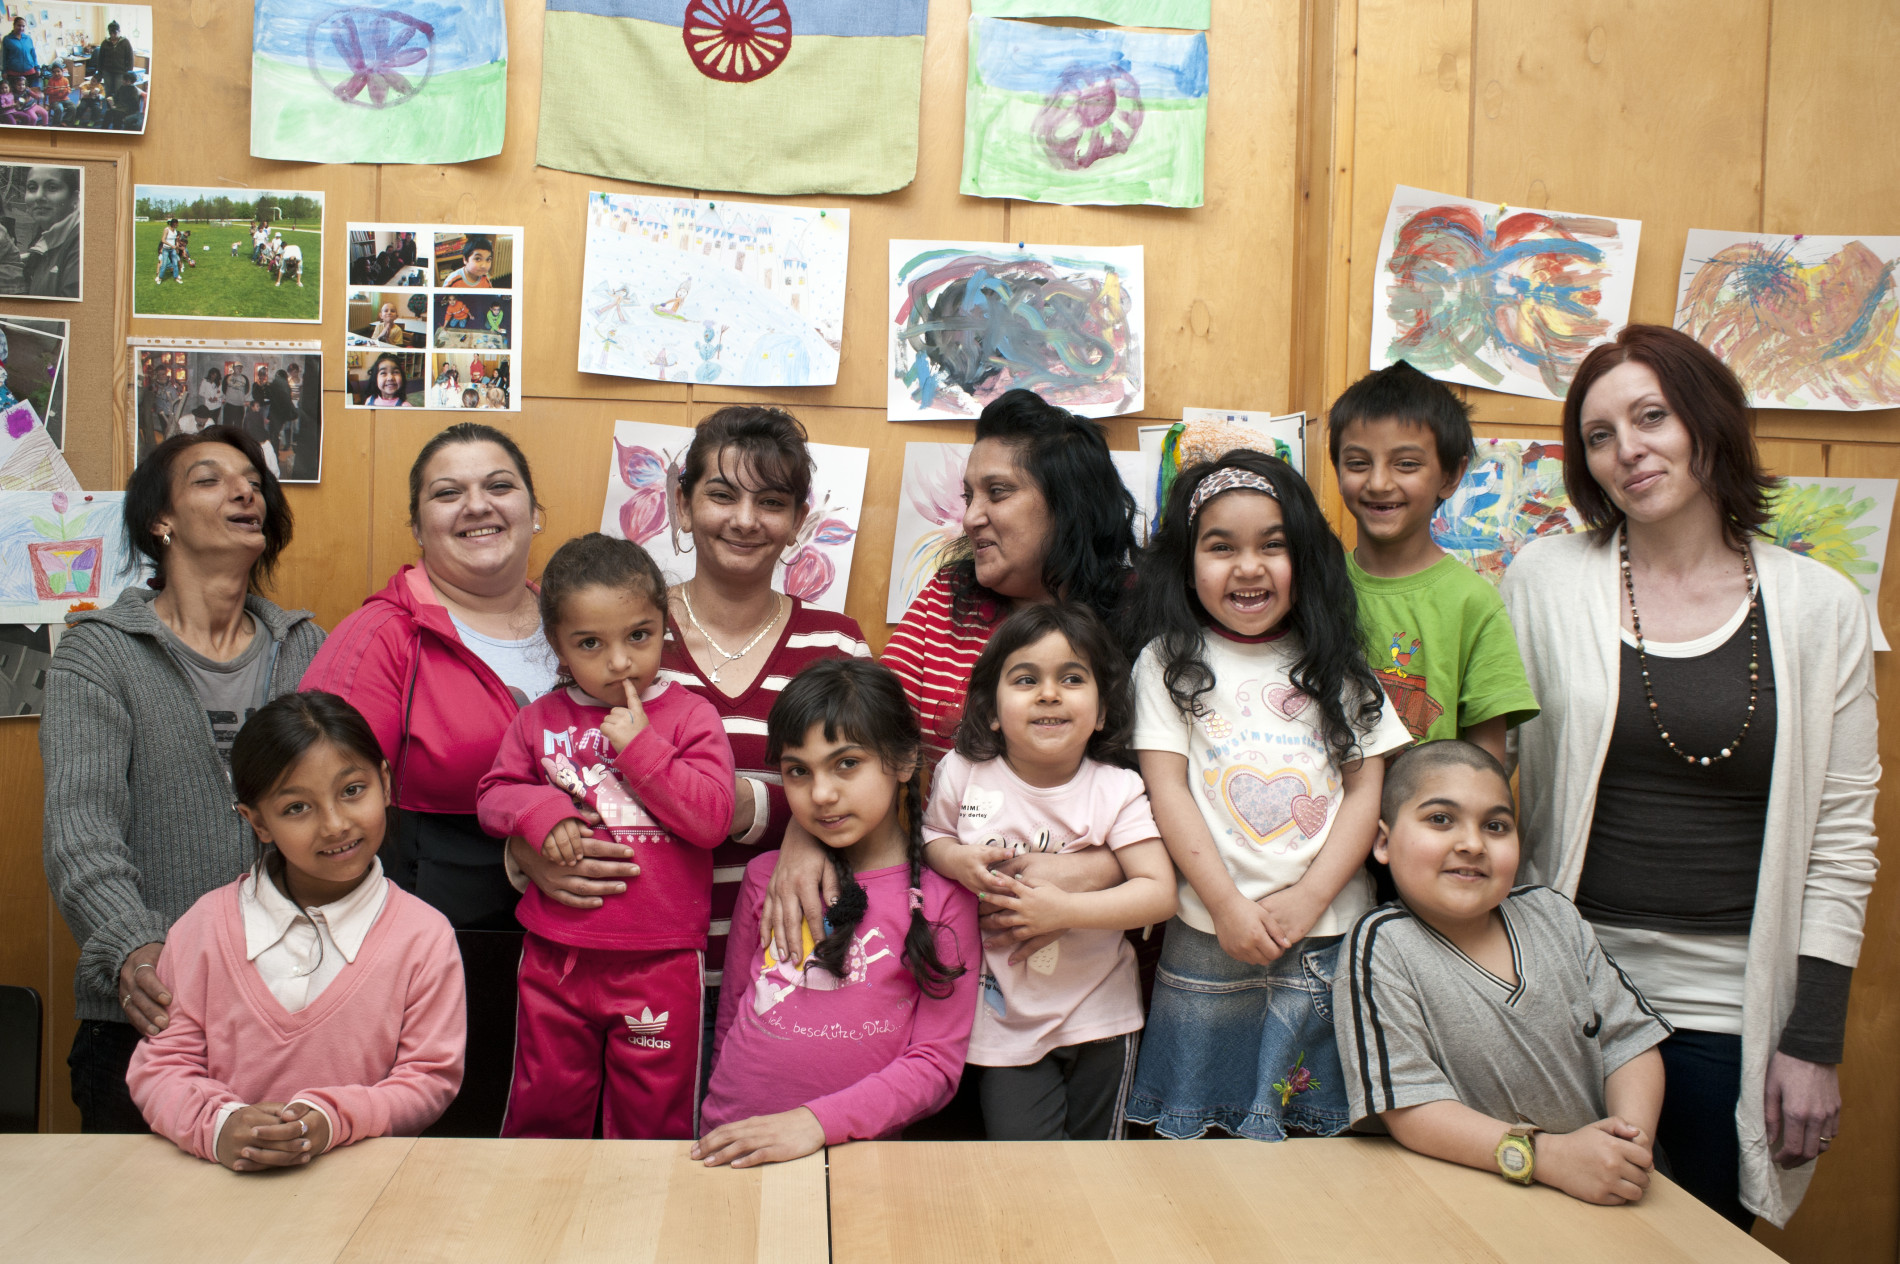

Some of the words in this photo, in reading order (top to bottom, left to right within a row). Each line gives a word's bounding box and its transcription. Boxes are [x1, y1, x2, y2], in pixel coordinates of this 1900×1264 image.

[543, 726, 610, 758] Min
[793, 1021, 864, 1041] beschütze
[627, 1035, 671, 1050] adidas
